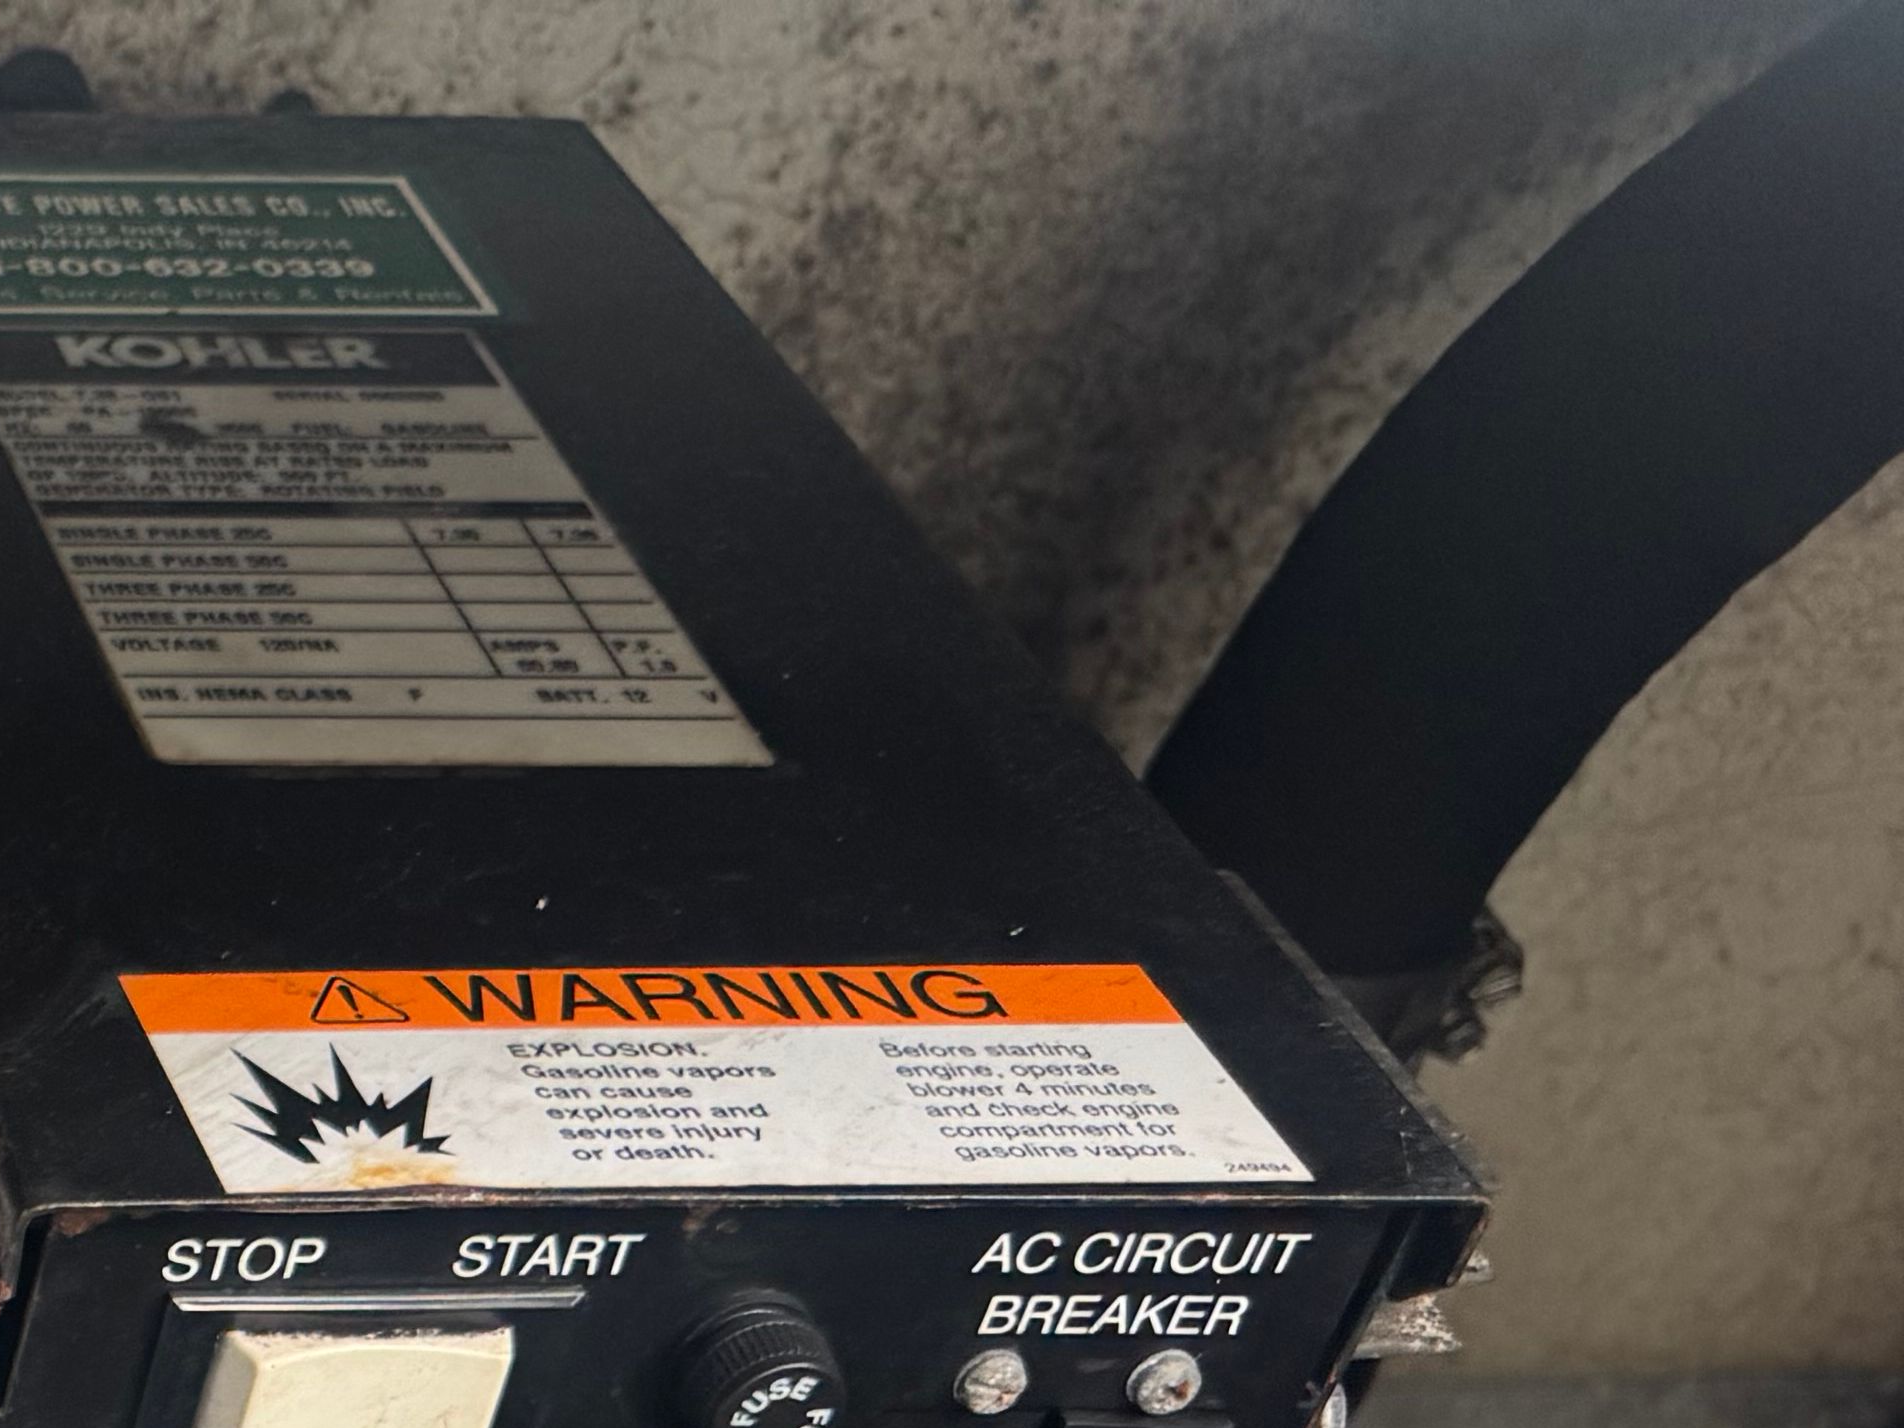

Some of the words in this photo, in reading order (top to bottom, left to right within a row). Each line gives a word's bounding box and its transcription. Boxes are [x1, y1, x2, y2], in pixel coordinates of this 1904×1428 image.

[34, 195, 141, 216] POWER
[156, 195, 256, 216] SALES
[58, 336, 386, 370] KOHLER
[162, 555, 240, 568] PHASE
[168, 583, 245, 596] PHASE
[183, 612, 261, 625] PHASE
[423, 969, 1010, 1024] WARNING
[507, 1041, 708, 1060] EXPLOSION.
[879, 1041, 977, 1060] Before
[984, 1041, 1094, 1062] starting
[520, 1063, 659, 1081] Gasoline
[668, 1066, 777, 1084] vapors
[895, 1063, 997, 1082] engine,
[1010, 1062, 1121, 1082] operate
[533, 1087, 590, 1100] can
[597, 1086, 693, 1100] cause
[907, 1081, 1004, 1098] blower
[1014, 1081, 1033, 1096] 4
[1040, 1081, 1157, 1098] minutes
[546, 1104, 702, 1124] explosion
[710, 1103, 771, 1120] and
[926, 1103, 980, 1119] and
[988, 1102, 1076, 1119] check
[1081, 1102, 1181, 1122] engine
[558, 1127, 666, 1142] severe
[672, 1124, 764, 1145] injury
[939, 1122, 1128, 1142] compartment
[1135, 1121, 1178, 1138] for
[571, 1147, 603, 1161] or
[609, 1143, 717, 1161] death.
[954, 1142, 1078, 1162] gasoline
[1086, 1144, 1195, 1162] vapors.
[161, 1237, 327, 1283] STOP
[449, 1233, 647, 1279] START
[971, 1232, 1059, 1275] AC
[1073, 1231, 1314, 1275] CIRCUIT
[977, 1294, 1250, 1336] BREAKER
[731, 1375, 823, 1428] FUSE
